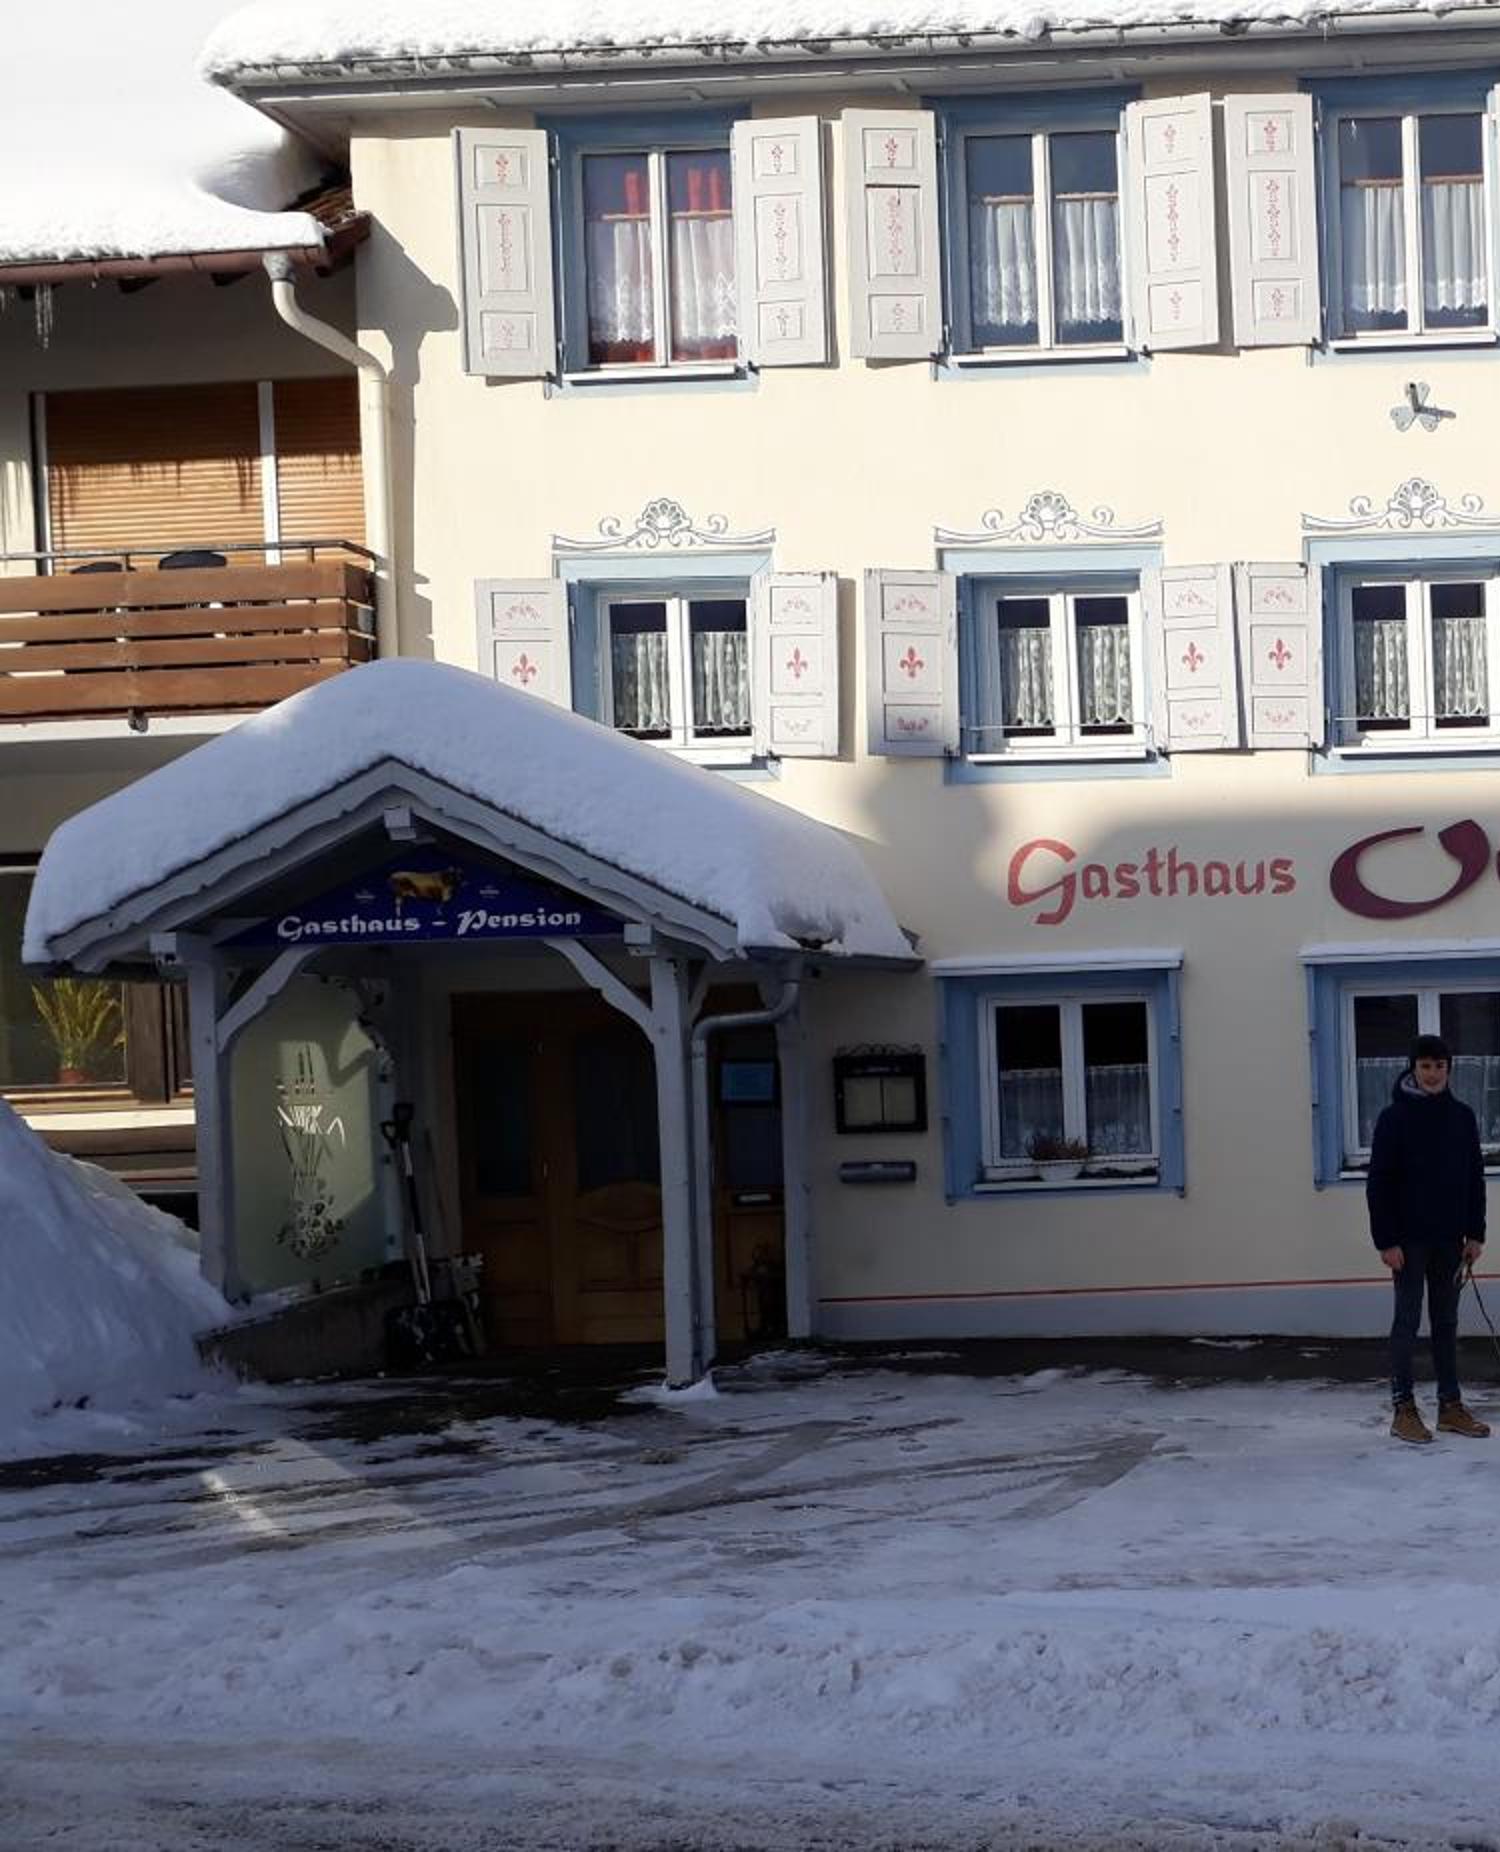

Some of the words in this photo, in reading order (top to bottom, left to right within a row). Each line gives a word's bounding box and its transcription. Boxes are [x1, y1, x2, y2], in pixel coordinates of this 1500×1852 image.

[1007, 838, 1296, 925] Gasthaus
[277, 915, 421, 939] Gasthaus
[457, 908, 582, 935] Pension
